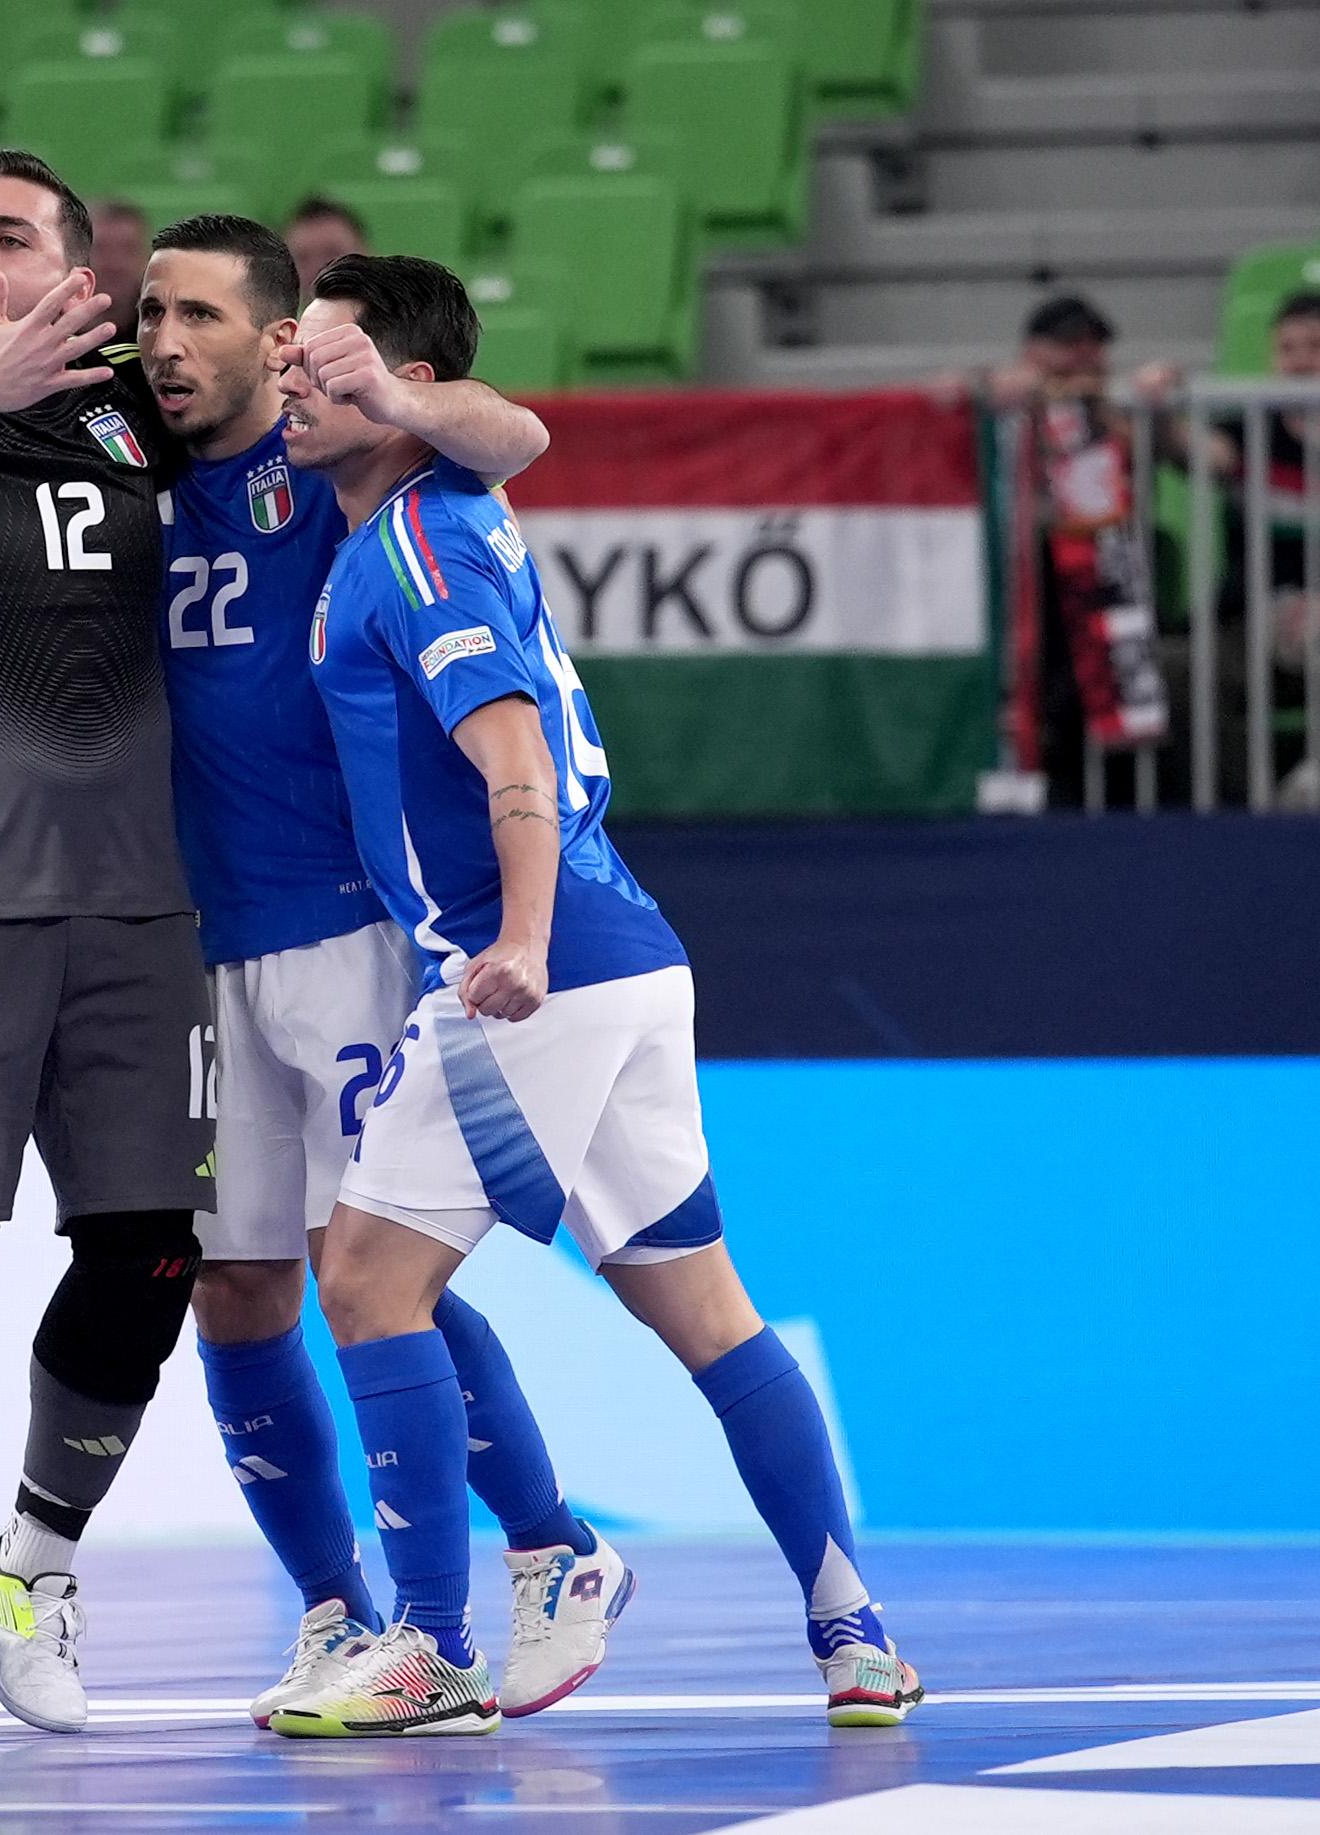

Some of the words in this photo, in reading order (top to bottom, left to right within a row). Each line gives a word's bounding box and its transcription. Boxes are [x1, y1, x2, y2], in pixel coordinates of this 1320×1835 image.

[90, 416, 125, 438] ITALIA
[251, 469, 285, 496] ITALIA
[35, 481, 113, 570] 12
[168, 551, 255, 649] 22
[423, 634, 491, 671] FOUNDATION
